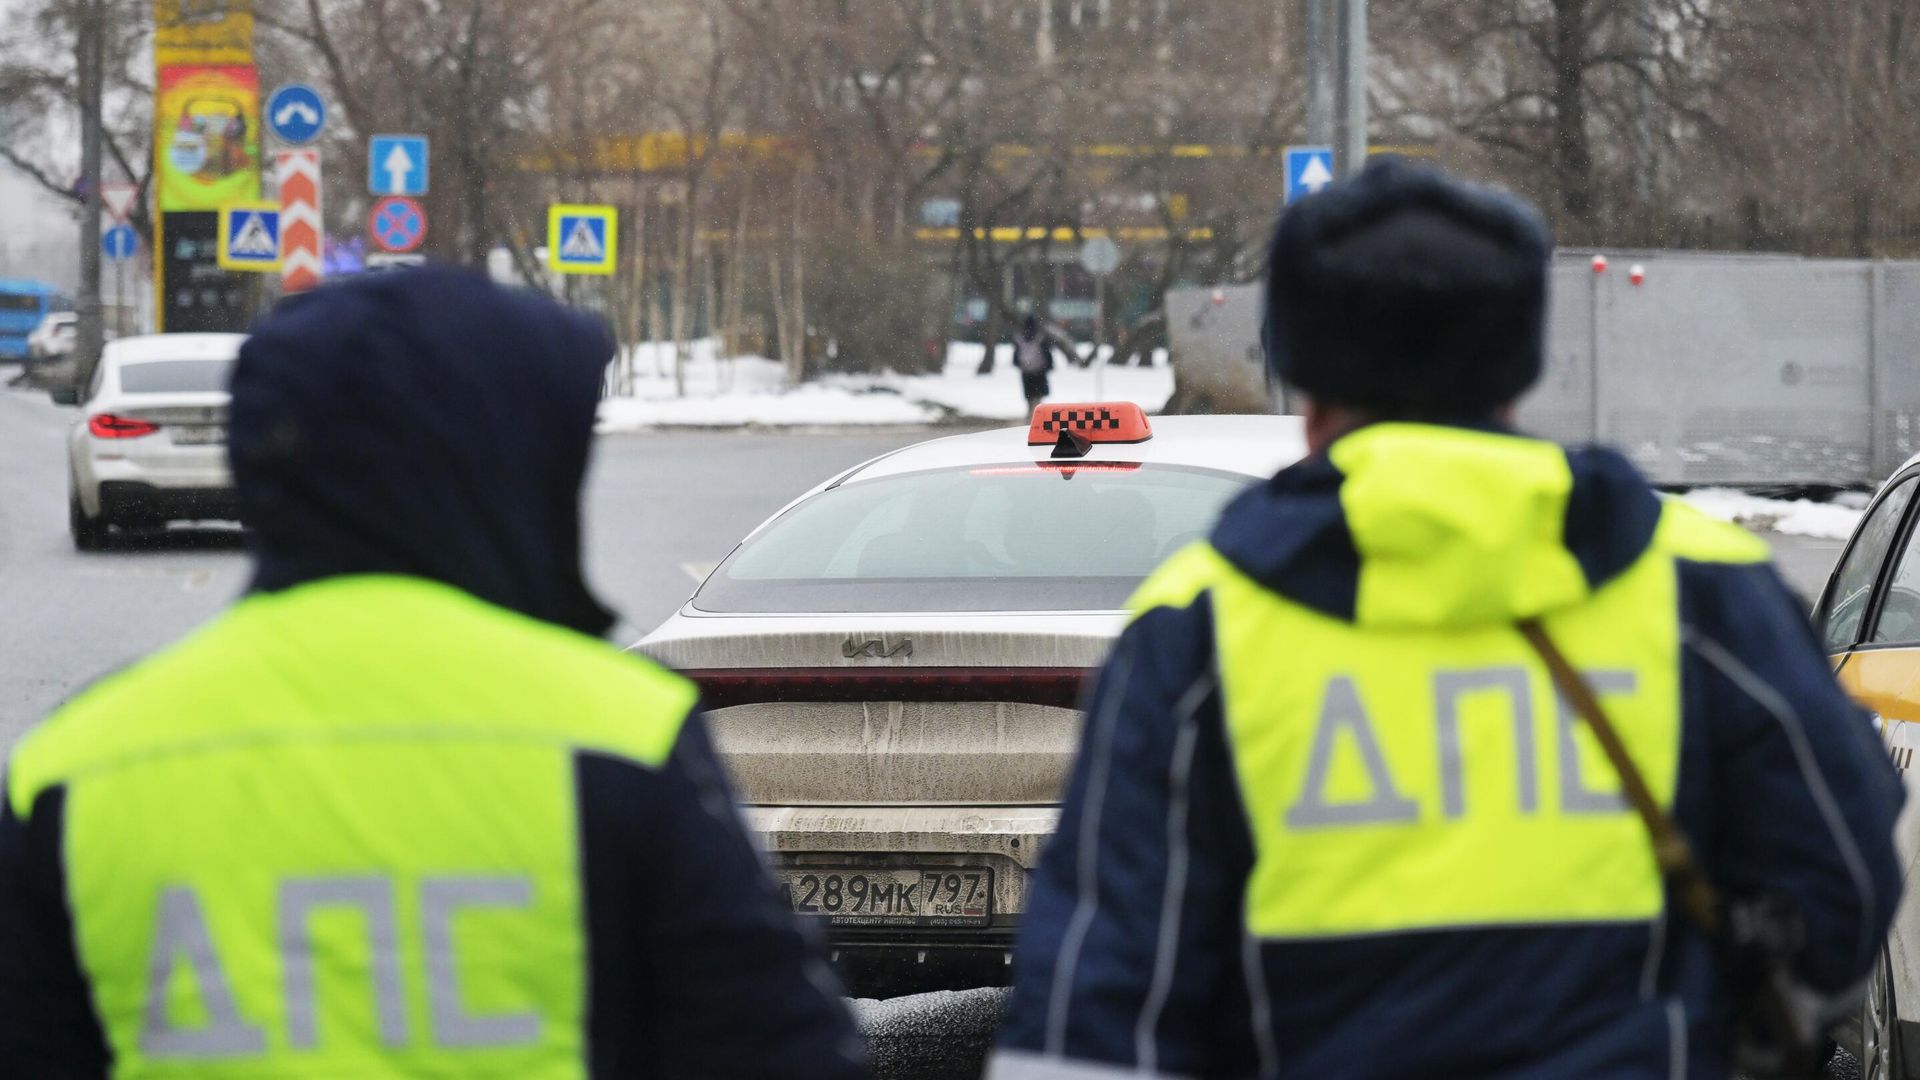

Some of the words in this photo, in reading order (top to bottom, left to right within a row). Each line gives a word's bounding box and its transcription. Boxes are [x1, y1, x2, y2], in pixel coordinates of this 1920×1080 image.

[1284, 667, 1637, 832] ДПС
[925, 873, 981, 902] 797
[935, 904, 962, 915] RUS
[141, 874, 543, 1056] ДПС
